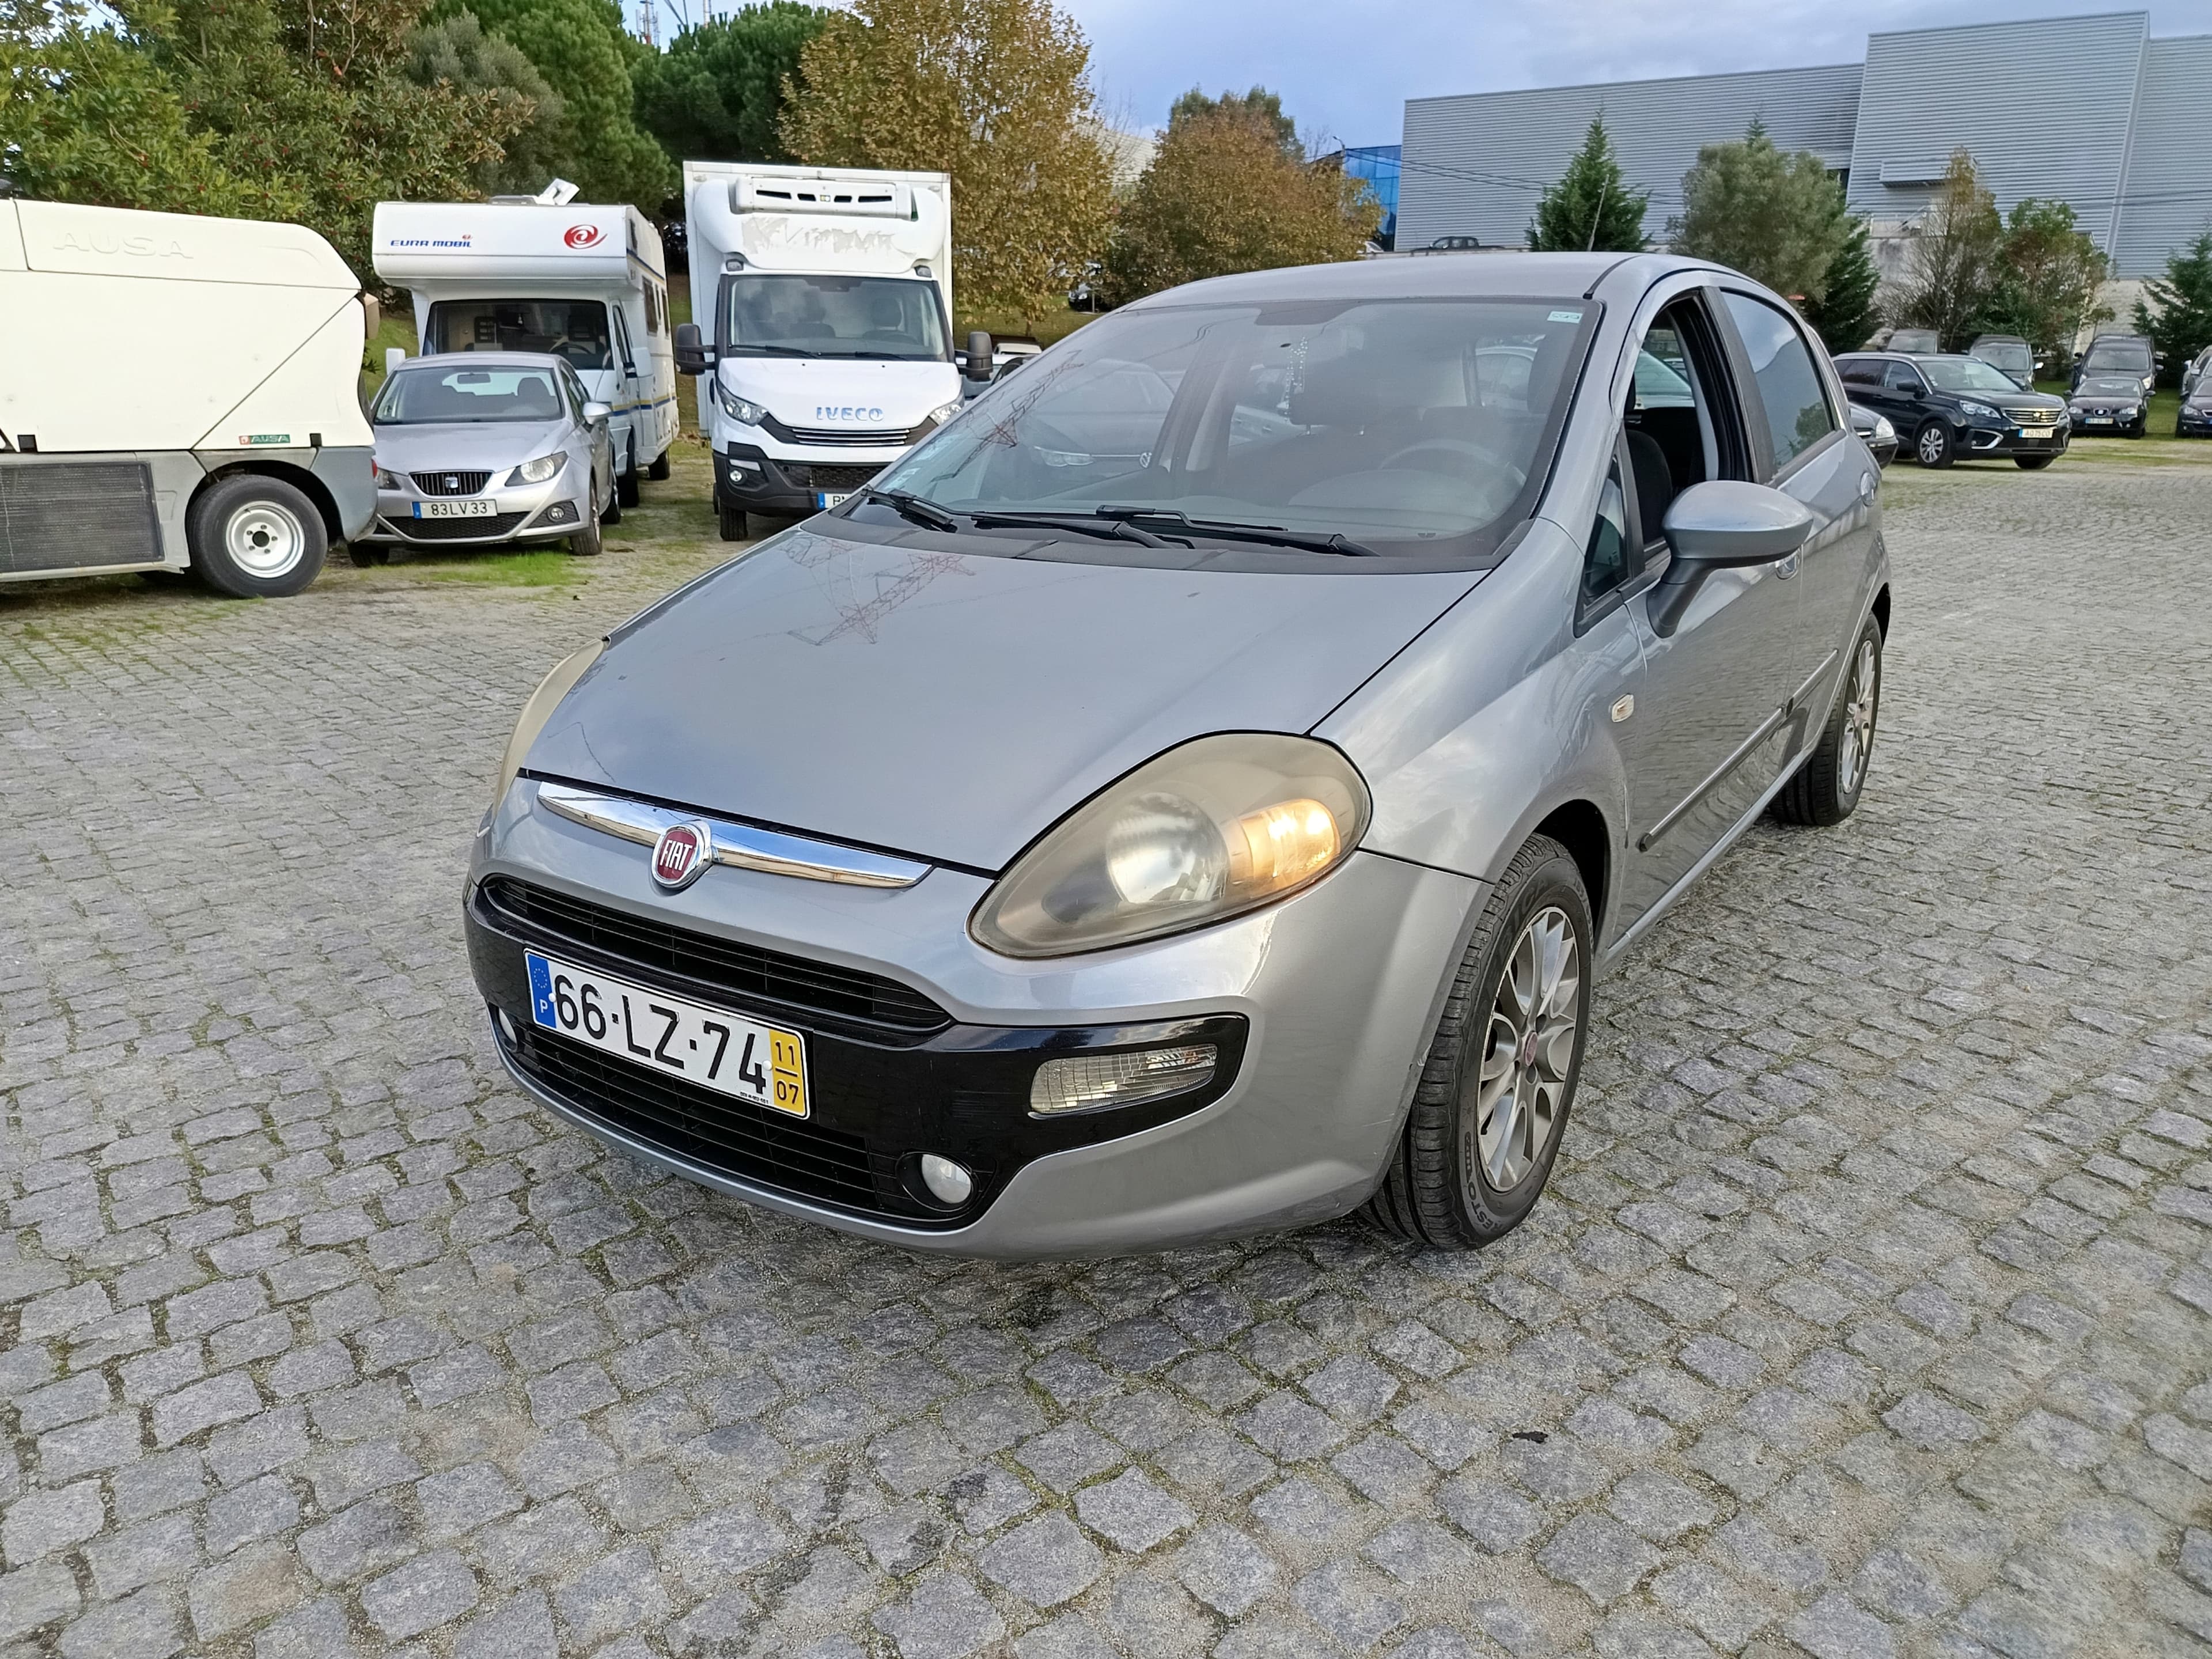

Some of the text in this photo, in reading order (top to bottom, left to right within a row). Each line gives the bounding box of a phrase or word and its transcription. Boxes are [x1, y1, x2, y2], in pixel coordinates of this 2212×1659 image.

[52, 231, 194, 260] AUSA
[816, 407, 885, 422] IVECO
[251, 434, 290, 443] AUSA
[659, 839, 694, 872] FIAT
[539, 999, 548, 1013] P
[775, 1041, 796, 1066] 11
[777, 1080, 800, 1104] 07
